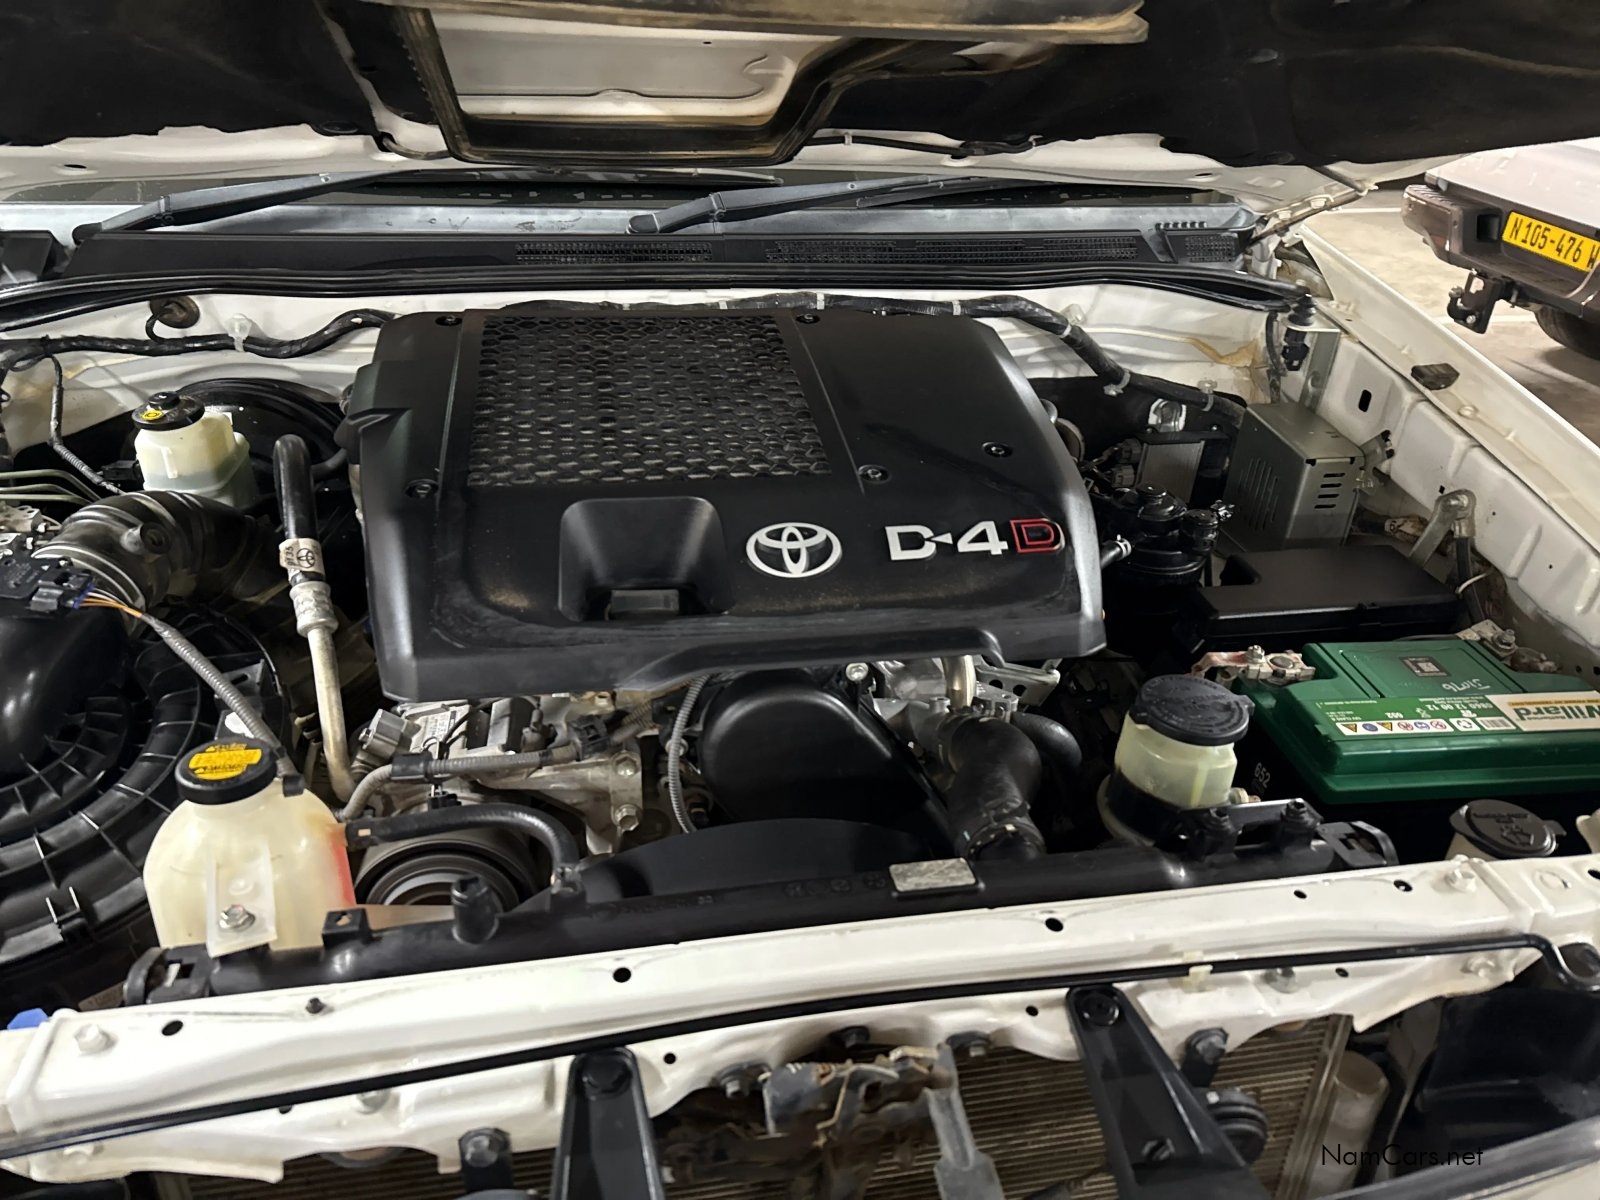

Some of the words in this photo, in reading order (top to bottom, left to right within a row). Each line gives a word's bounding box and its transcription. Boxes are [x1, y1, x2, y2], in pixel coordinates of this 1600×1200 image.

[1510, 217, 1523, 240] N
[1521, 221, 1584, 262] 105-476
[1255, 762, 1270, 788] 652
